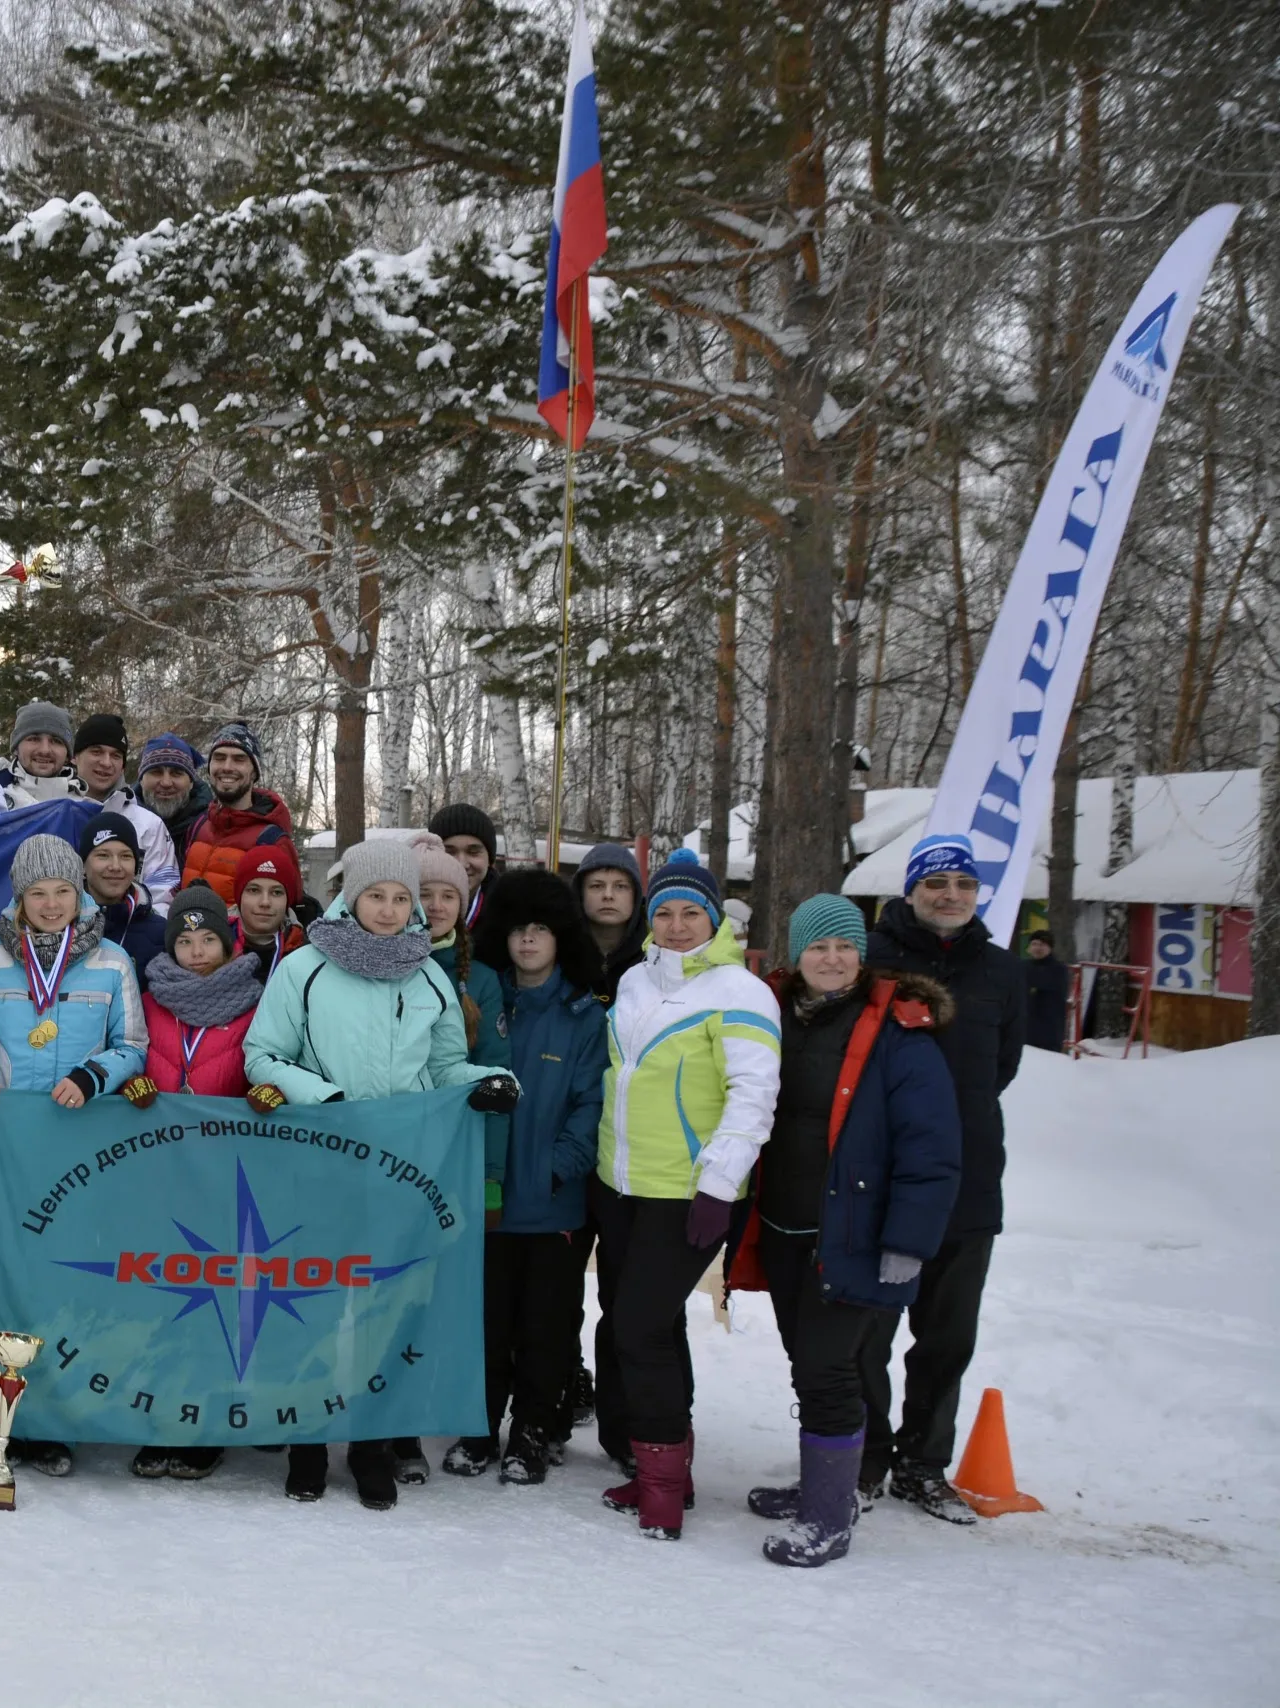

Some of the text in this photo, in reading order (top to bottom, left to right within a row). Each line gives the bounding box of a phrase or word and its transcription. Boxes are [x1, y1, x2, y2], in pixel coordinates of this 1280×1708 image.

[970, 426, 1125, 922] АНАРАГА
[96, 829, 112, 840] NIKE
[21, 1120, 456, 1235] Центр детско-юношеского туризма
[116, 1251, 372, 1288] КОСМОС
[56, 1337, 424, 1430] Челябинск
